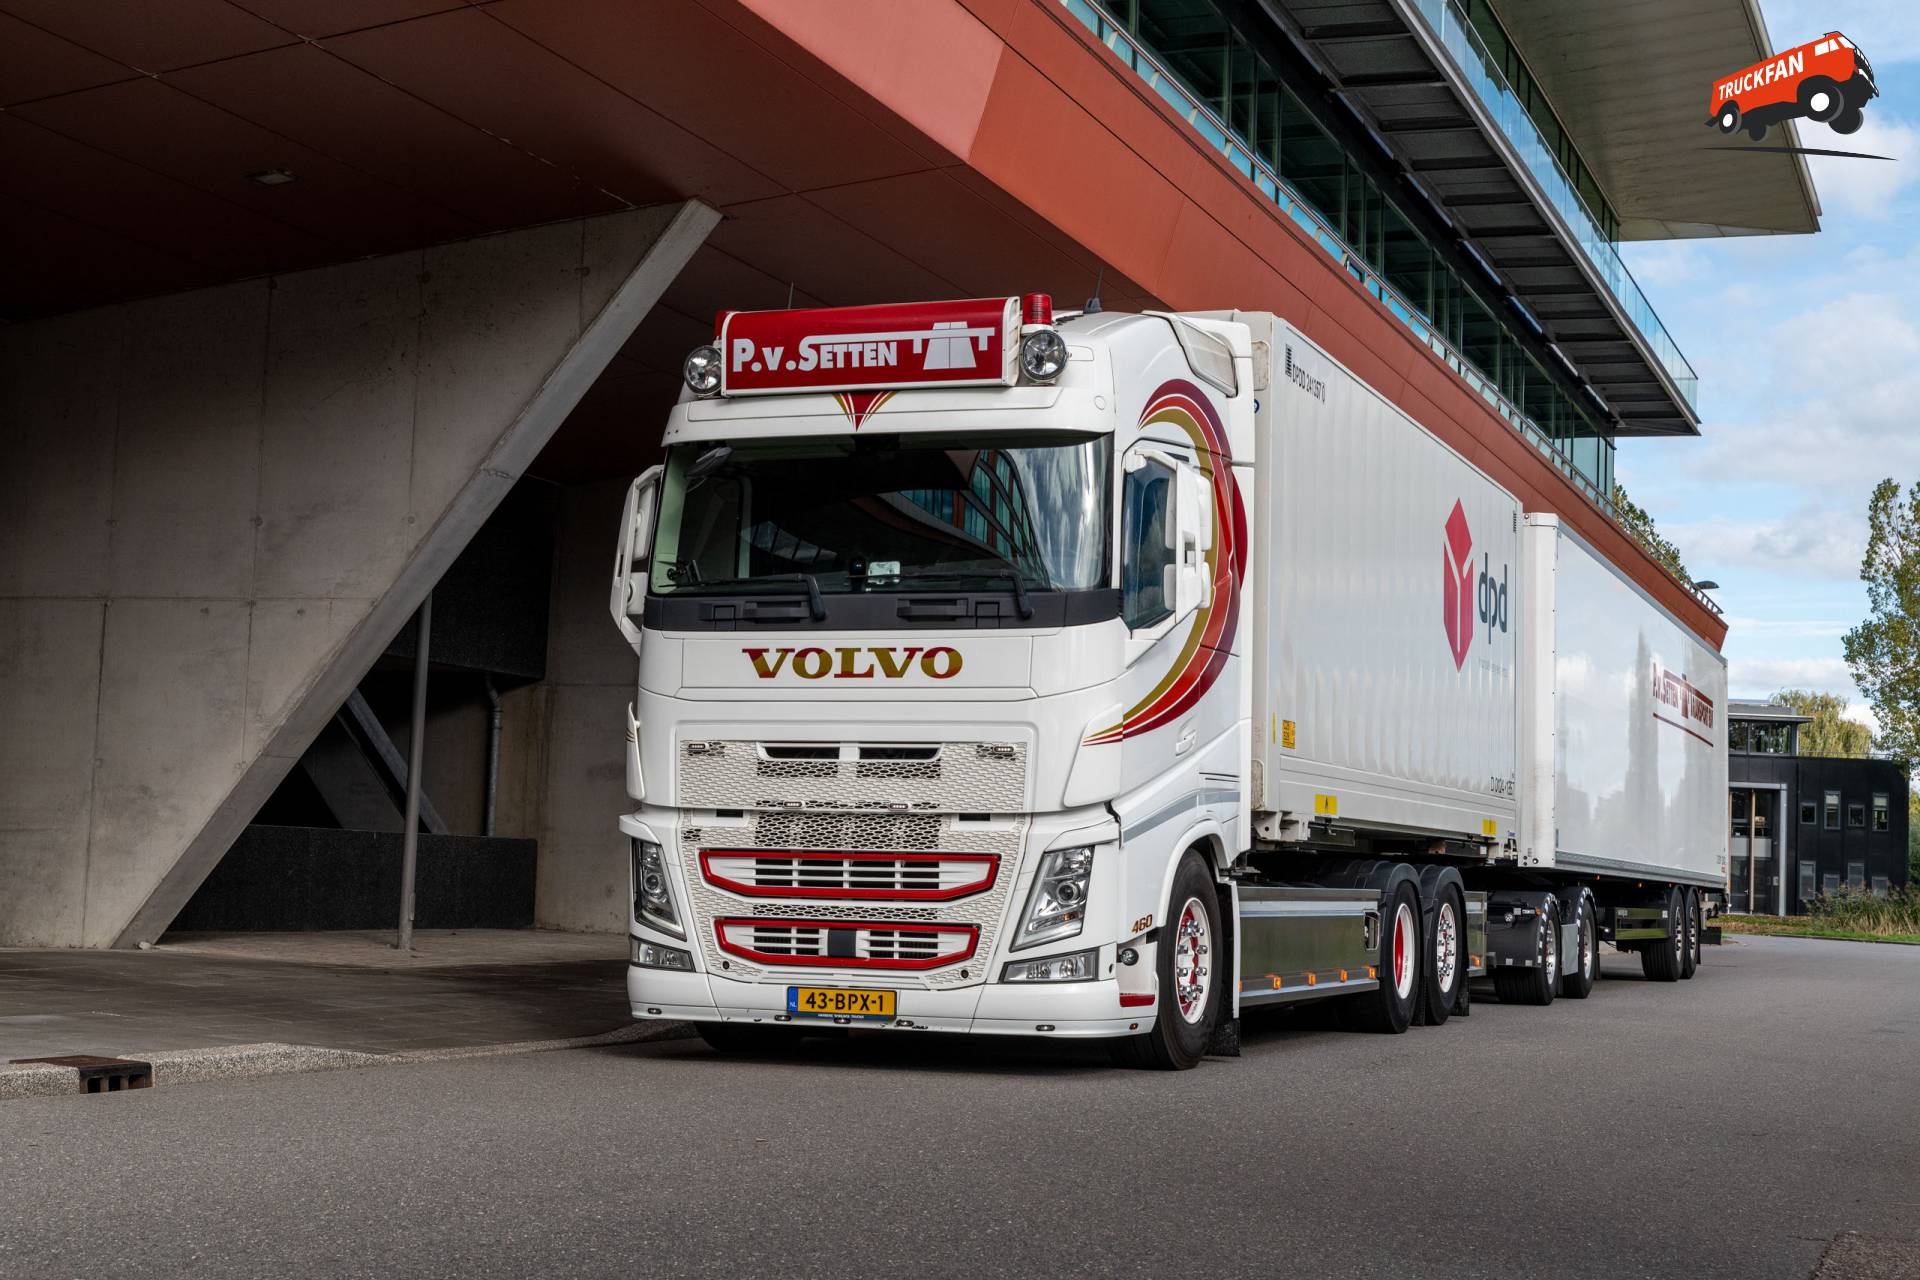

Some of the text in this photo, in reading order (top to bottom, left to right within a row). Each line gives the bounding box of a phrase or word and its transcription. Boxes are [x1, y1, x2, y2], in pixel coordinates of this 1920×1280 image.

[1478, 551, 1508, 645] dpd
[741, 646, 963, 680] VOLVO
[1131, 914, 1153, 934] 460
[805, 991, 884, 1012] 43-BPX-1
